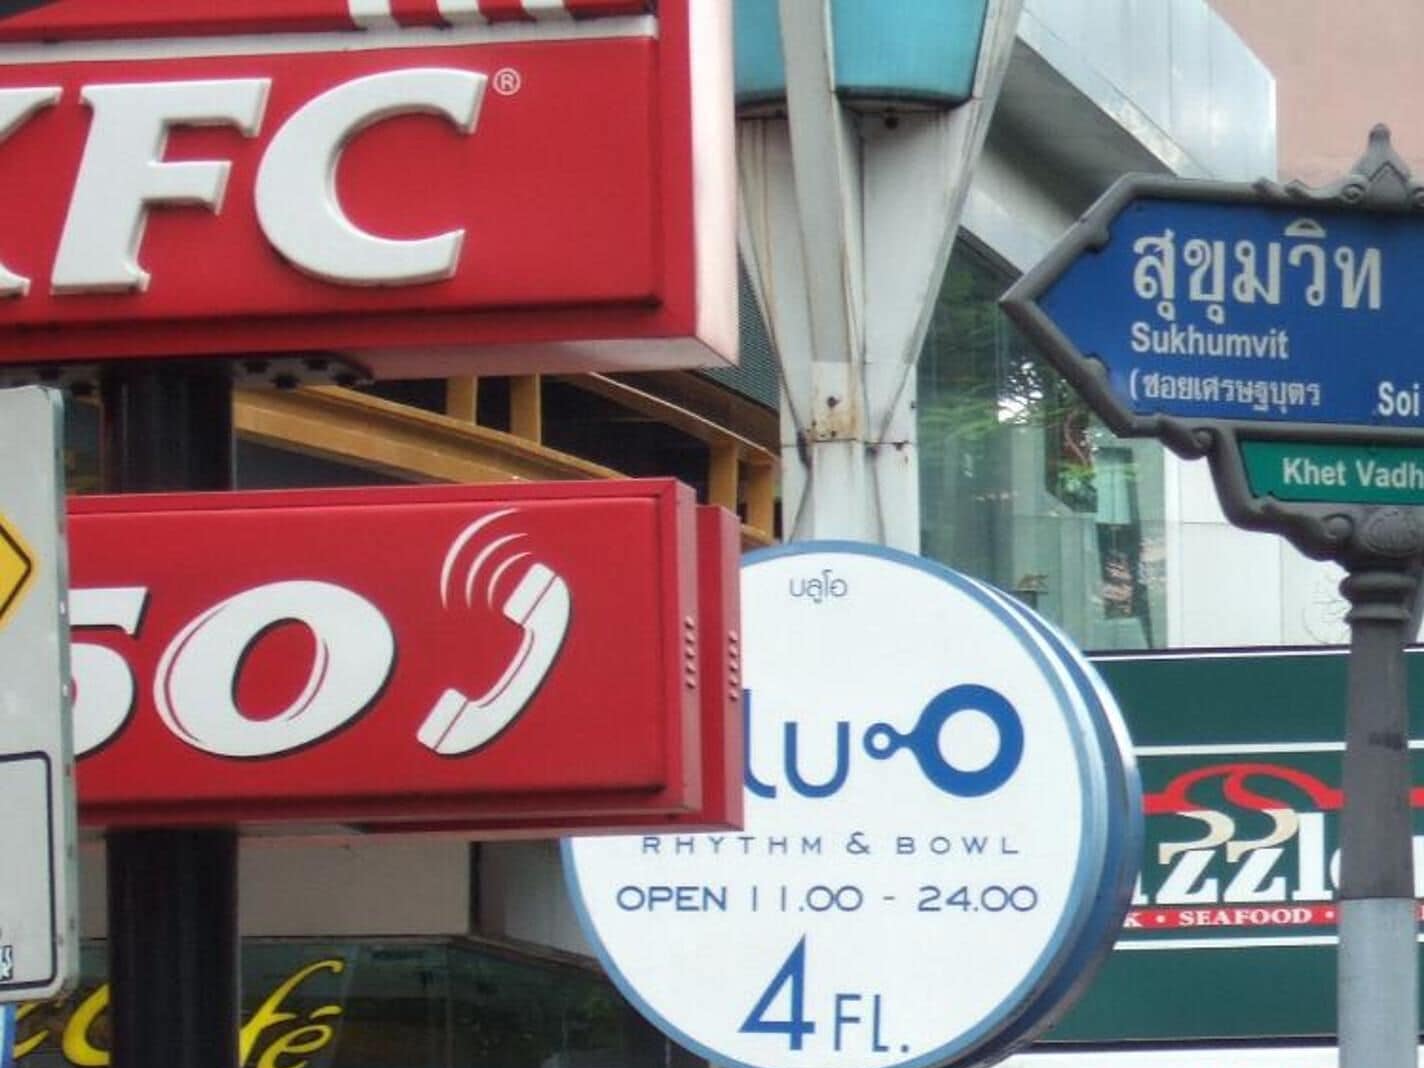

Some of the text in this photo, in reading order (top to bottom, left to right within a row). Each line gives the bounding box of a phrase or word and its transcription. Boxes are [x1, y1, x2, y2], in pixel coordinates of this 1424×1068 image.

[1132, 218, 1382, 324] สุขุมวิท
[1130, 321, 1289, 360] Sukhumvit
[1377, 380, 1420, 417] Soi
[1282, 456, 1346, 488] Khet
[642, 833, 1021, 856] RHYTHM & BOWL
[616, 885, 728, 912] OPEN
[750, 885, 864, 913] 11.00
[919, 885, 1039, 913] 24.00
[1179, 909, 1312, 926] SEAFOOD
[738, 933, 910, 1053] 4 FL.
